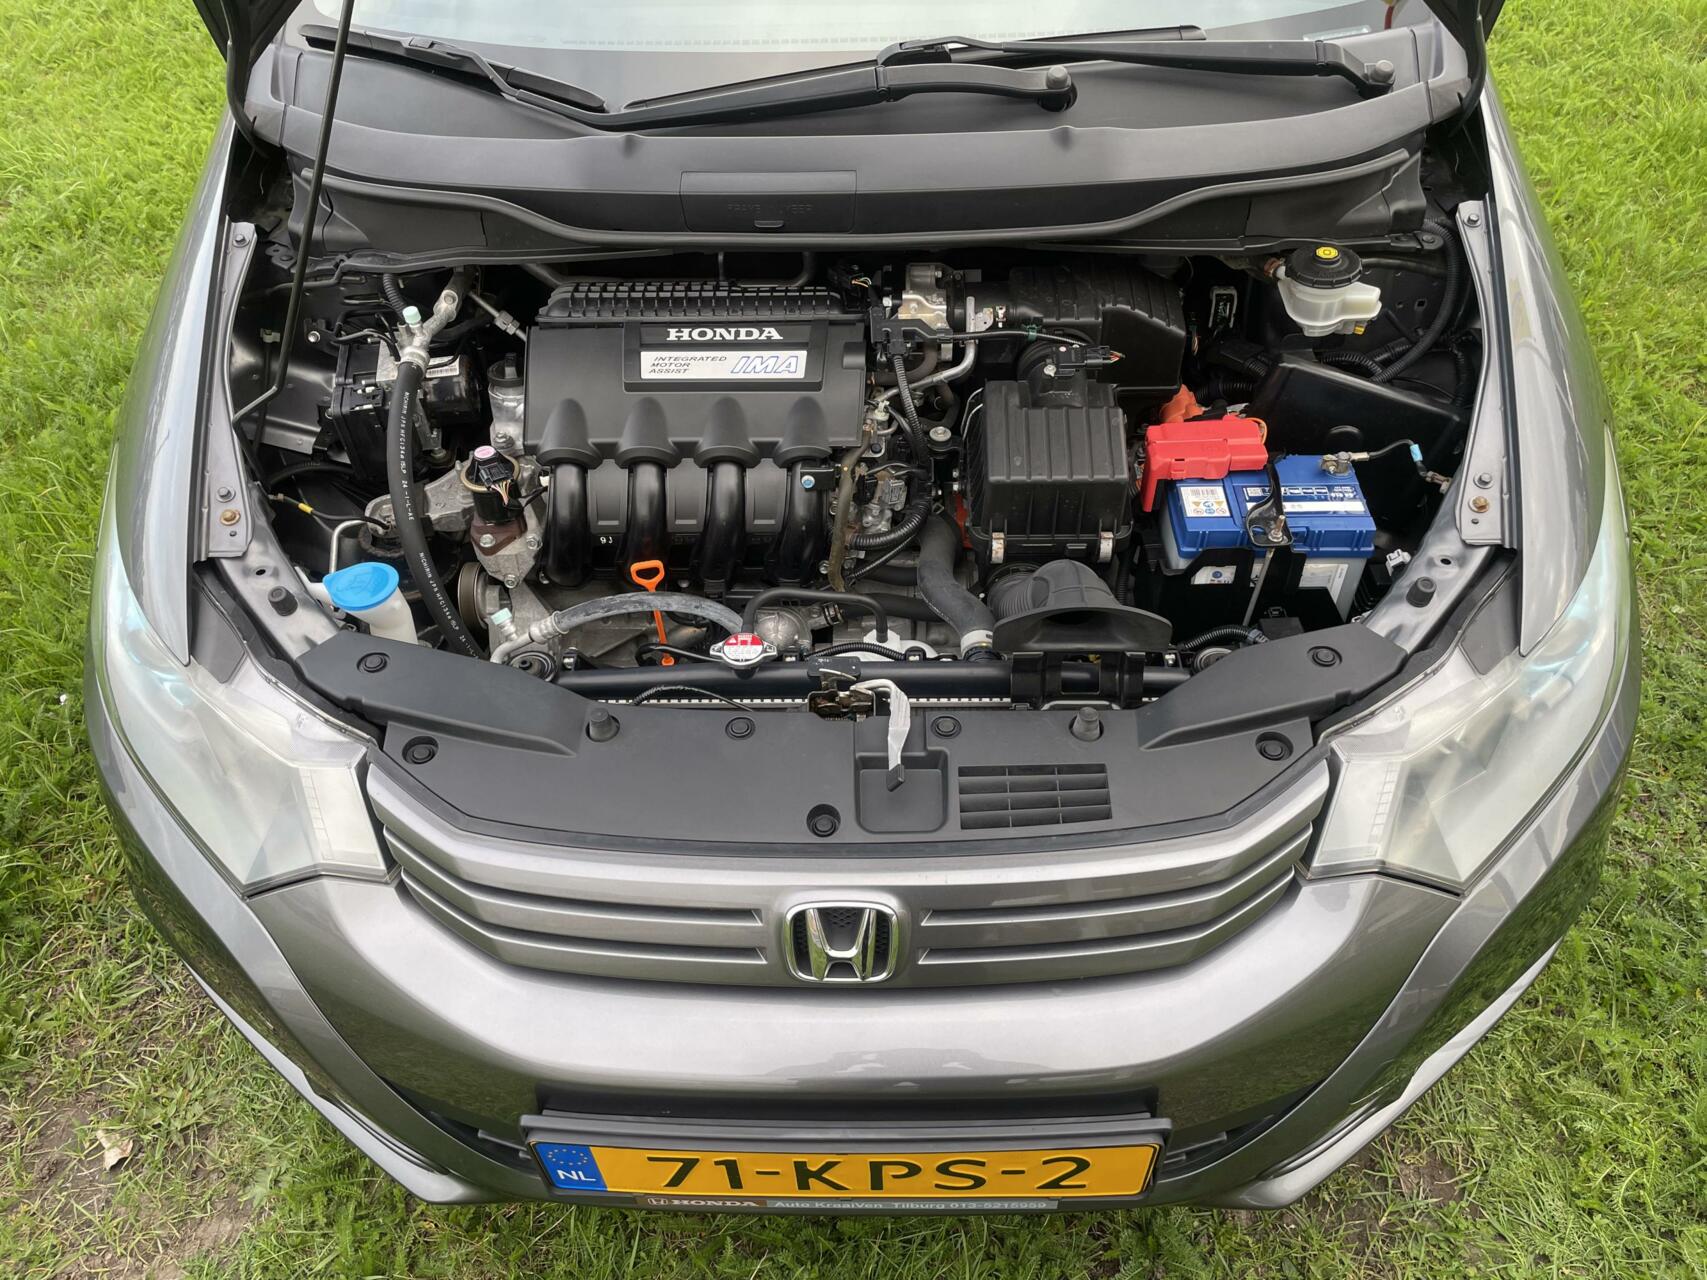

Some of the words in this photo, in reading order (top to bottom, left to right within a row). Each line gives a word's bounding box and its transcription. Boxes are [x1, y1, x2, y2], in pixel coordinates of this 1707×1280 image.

[666, 327, 784, 341] HONDA
[730, 355, 799, 374] IMA
[556, 1169, 597, 1182] NL
[646, 1154, 1092, 1192] 71-KPS-2
[671, 1199, 760, 1207] HONDA
[892, 1202, 945, 1210] Tilburg
